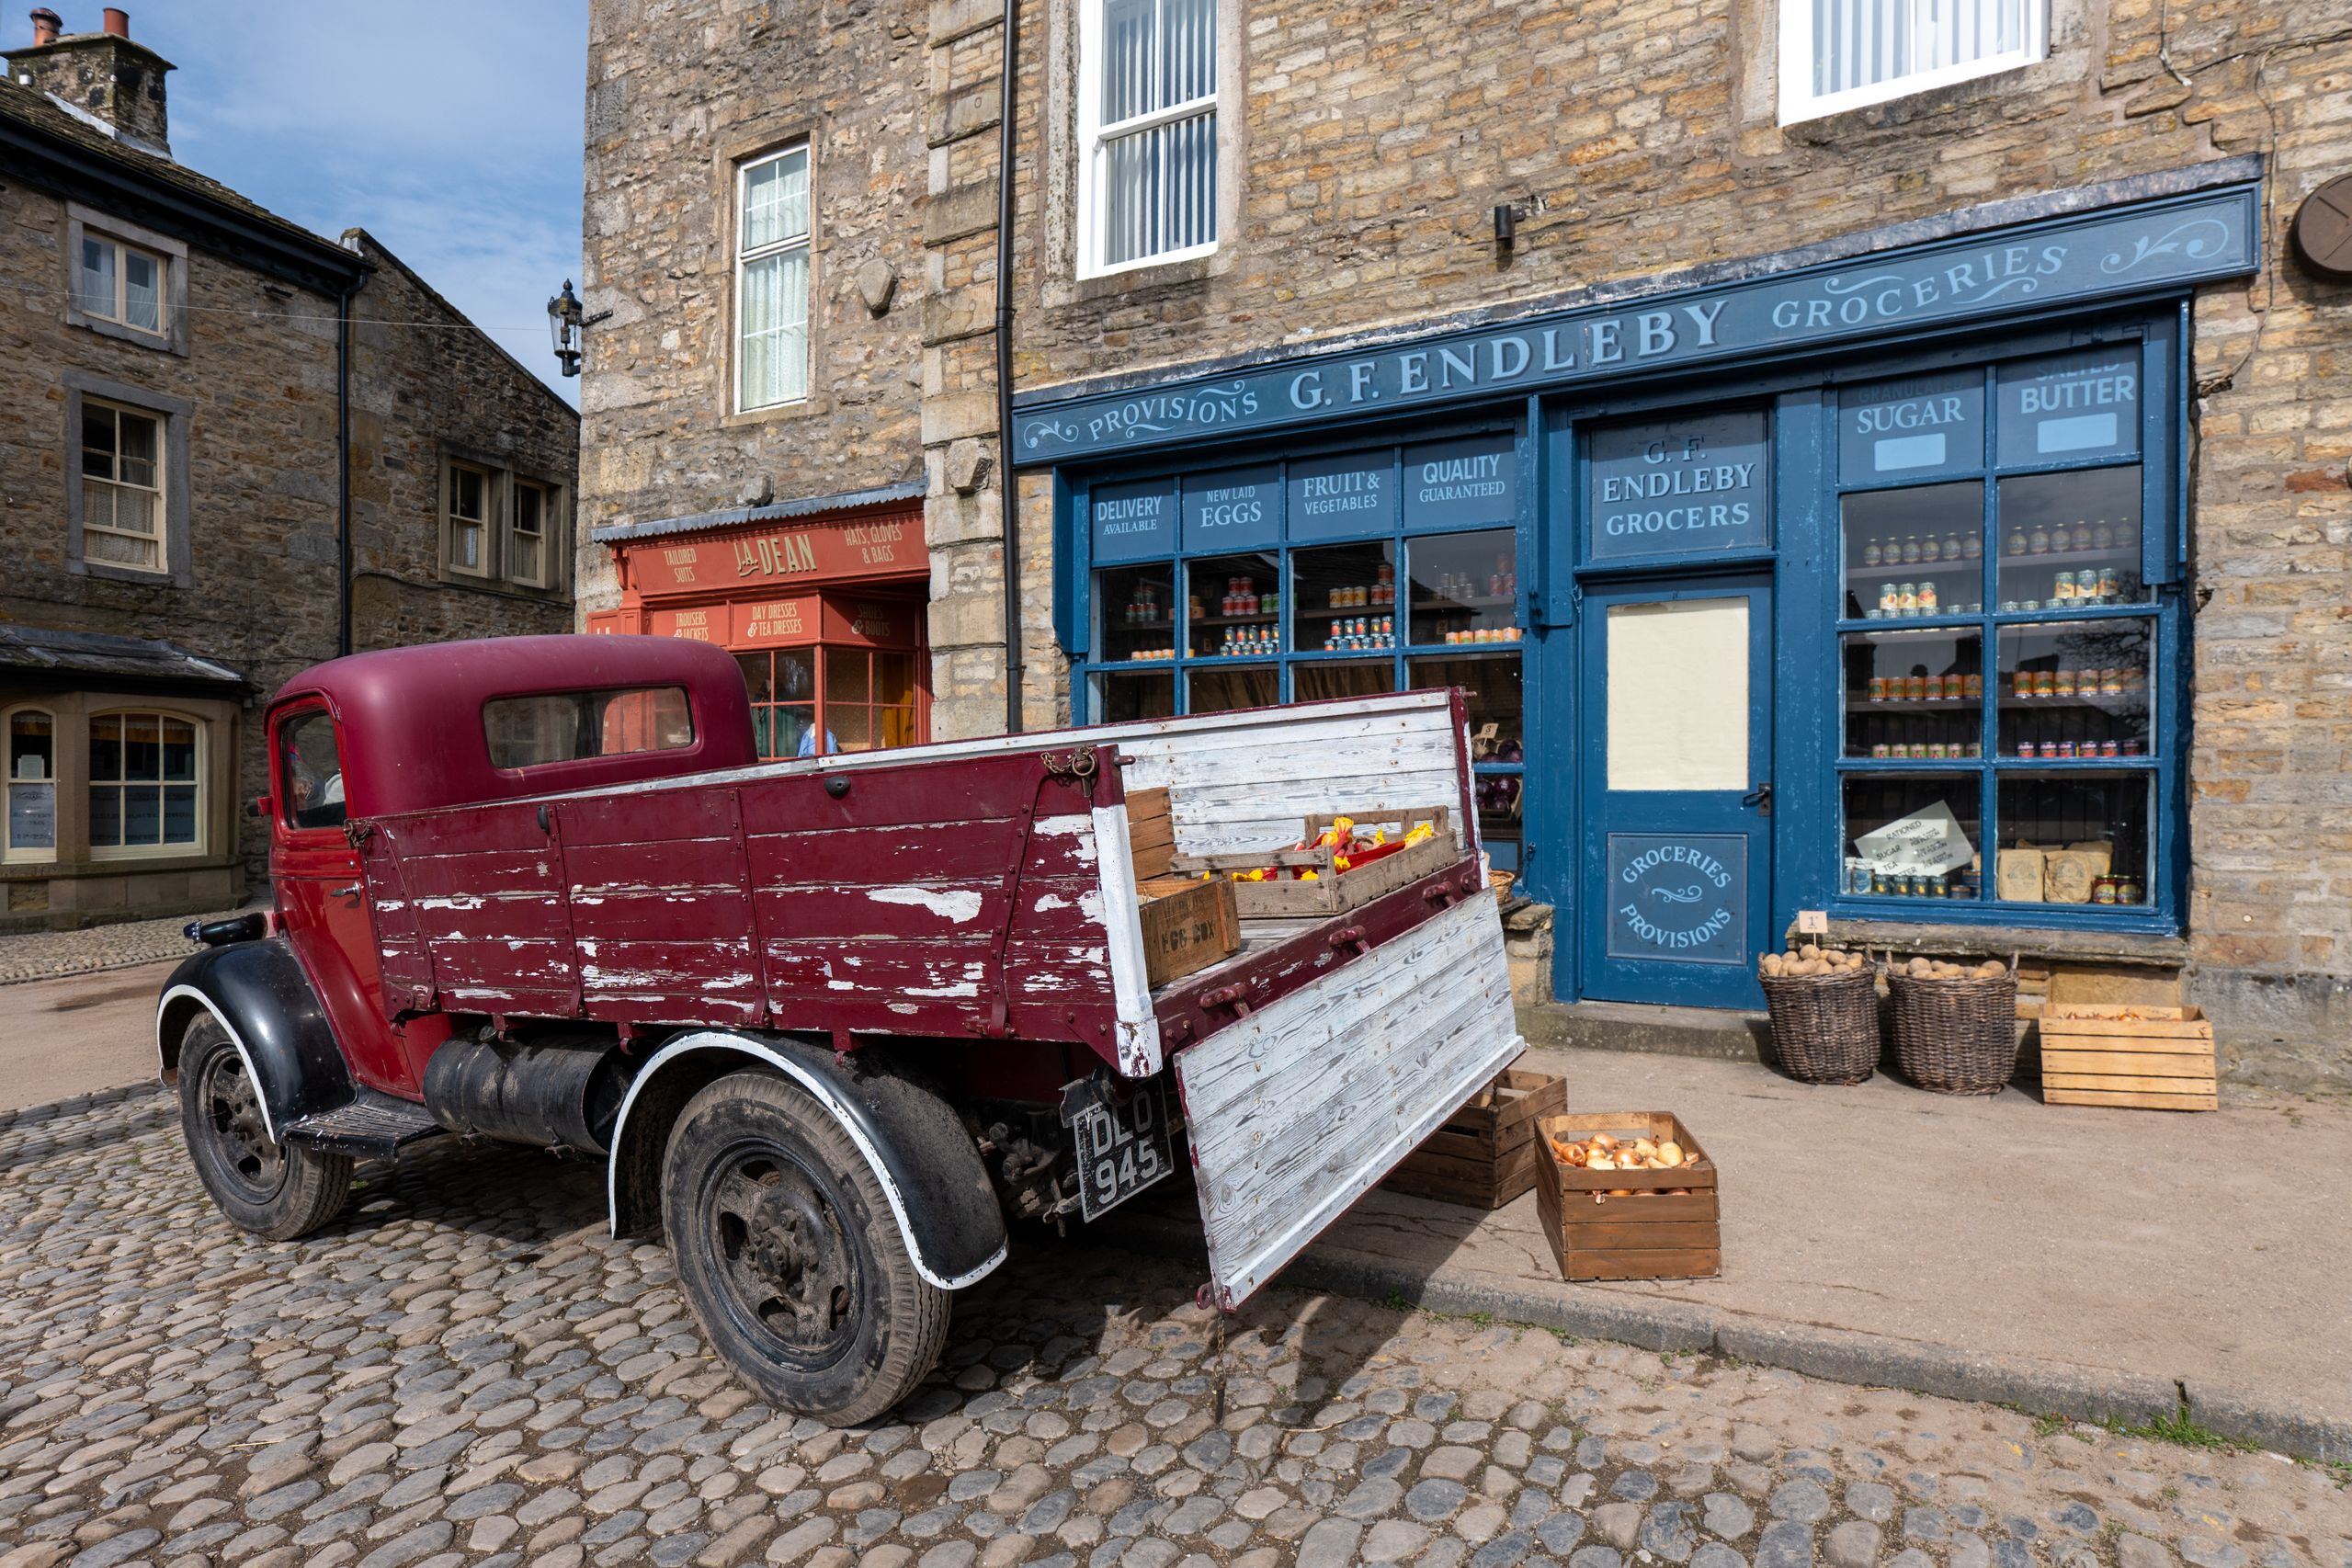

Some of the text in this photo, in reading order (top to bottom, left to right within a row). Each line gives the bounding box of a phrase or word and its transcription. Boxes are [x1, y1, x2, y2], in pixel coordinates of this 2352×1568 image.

[1772, 245, 2067, 328] GROCERIES
[1290, 300, 1729, 410] G. F. ENDLEBY
[2021, 375, 2135, 414] BUTTER
[1088, 392, 1258, 441] PROVISIONS
[1856, 396, 1965, 434] SUGAR
[1643, 437, 1708, 464] G. F.
[1422, 453, 1501, 484] QUALITY
[1207, 485, 1256, 503] NEW LAID
[1302, 472, 1381, 498] FRUIT &
[1419, 481, 1506, 503] GUARANTEED
[1603, 462, 1755, 502] ENDLEBY
[1097, 495, 1163, 521] DELIVERY
[1200, 501, 1261, 528] EGGS
[1304, 494, 1378, 515] VEGETABLES
[1103, 519, 1157, 535] AVAILABLE
[1606, 502, 1750, 536] GROCERS
[844, 524, 903, 546] HATS, GLOVES
[663, 547, 697, 566] TAILORED
[757, 534, 817, 575] DEAN
[861, 545, 894, 564] & BAGS
[674, 566, 696, 584] SUITS
[675, 610, 707, 627] TROUSERS
[752, 602, 797, 621] DAY DRESSES
[747, 619, 802, 638] & TEA DRESSES
[851, 619, 891, 637] & BOOTS
[1886, 820, 1922, 841] RATIONED
[1876, 844, 1903, 861] SUGAR
[1622, 846, 1732, 889] GROCERIES
[1882, 860, 1899, 872] TEA
[1619, 903, 1732, 949] PROVISIONS
[1095, 1133, 1158, 1205] 945
